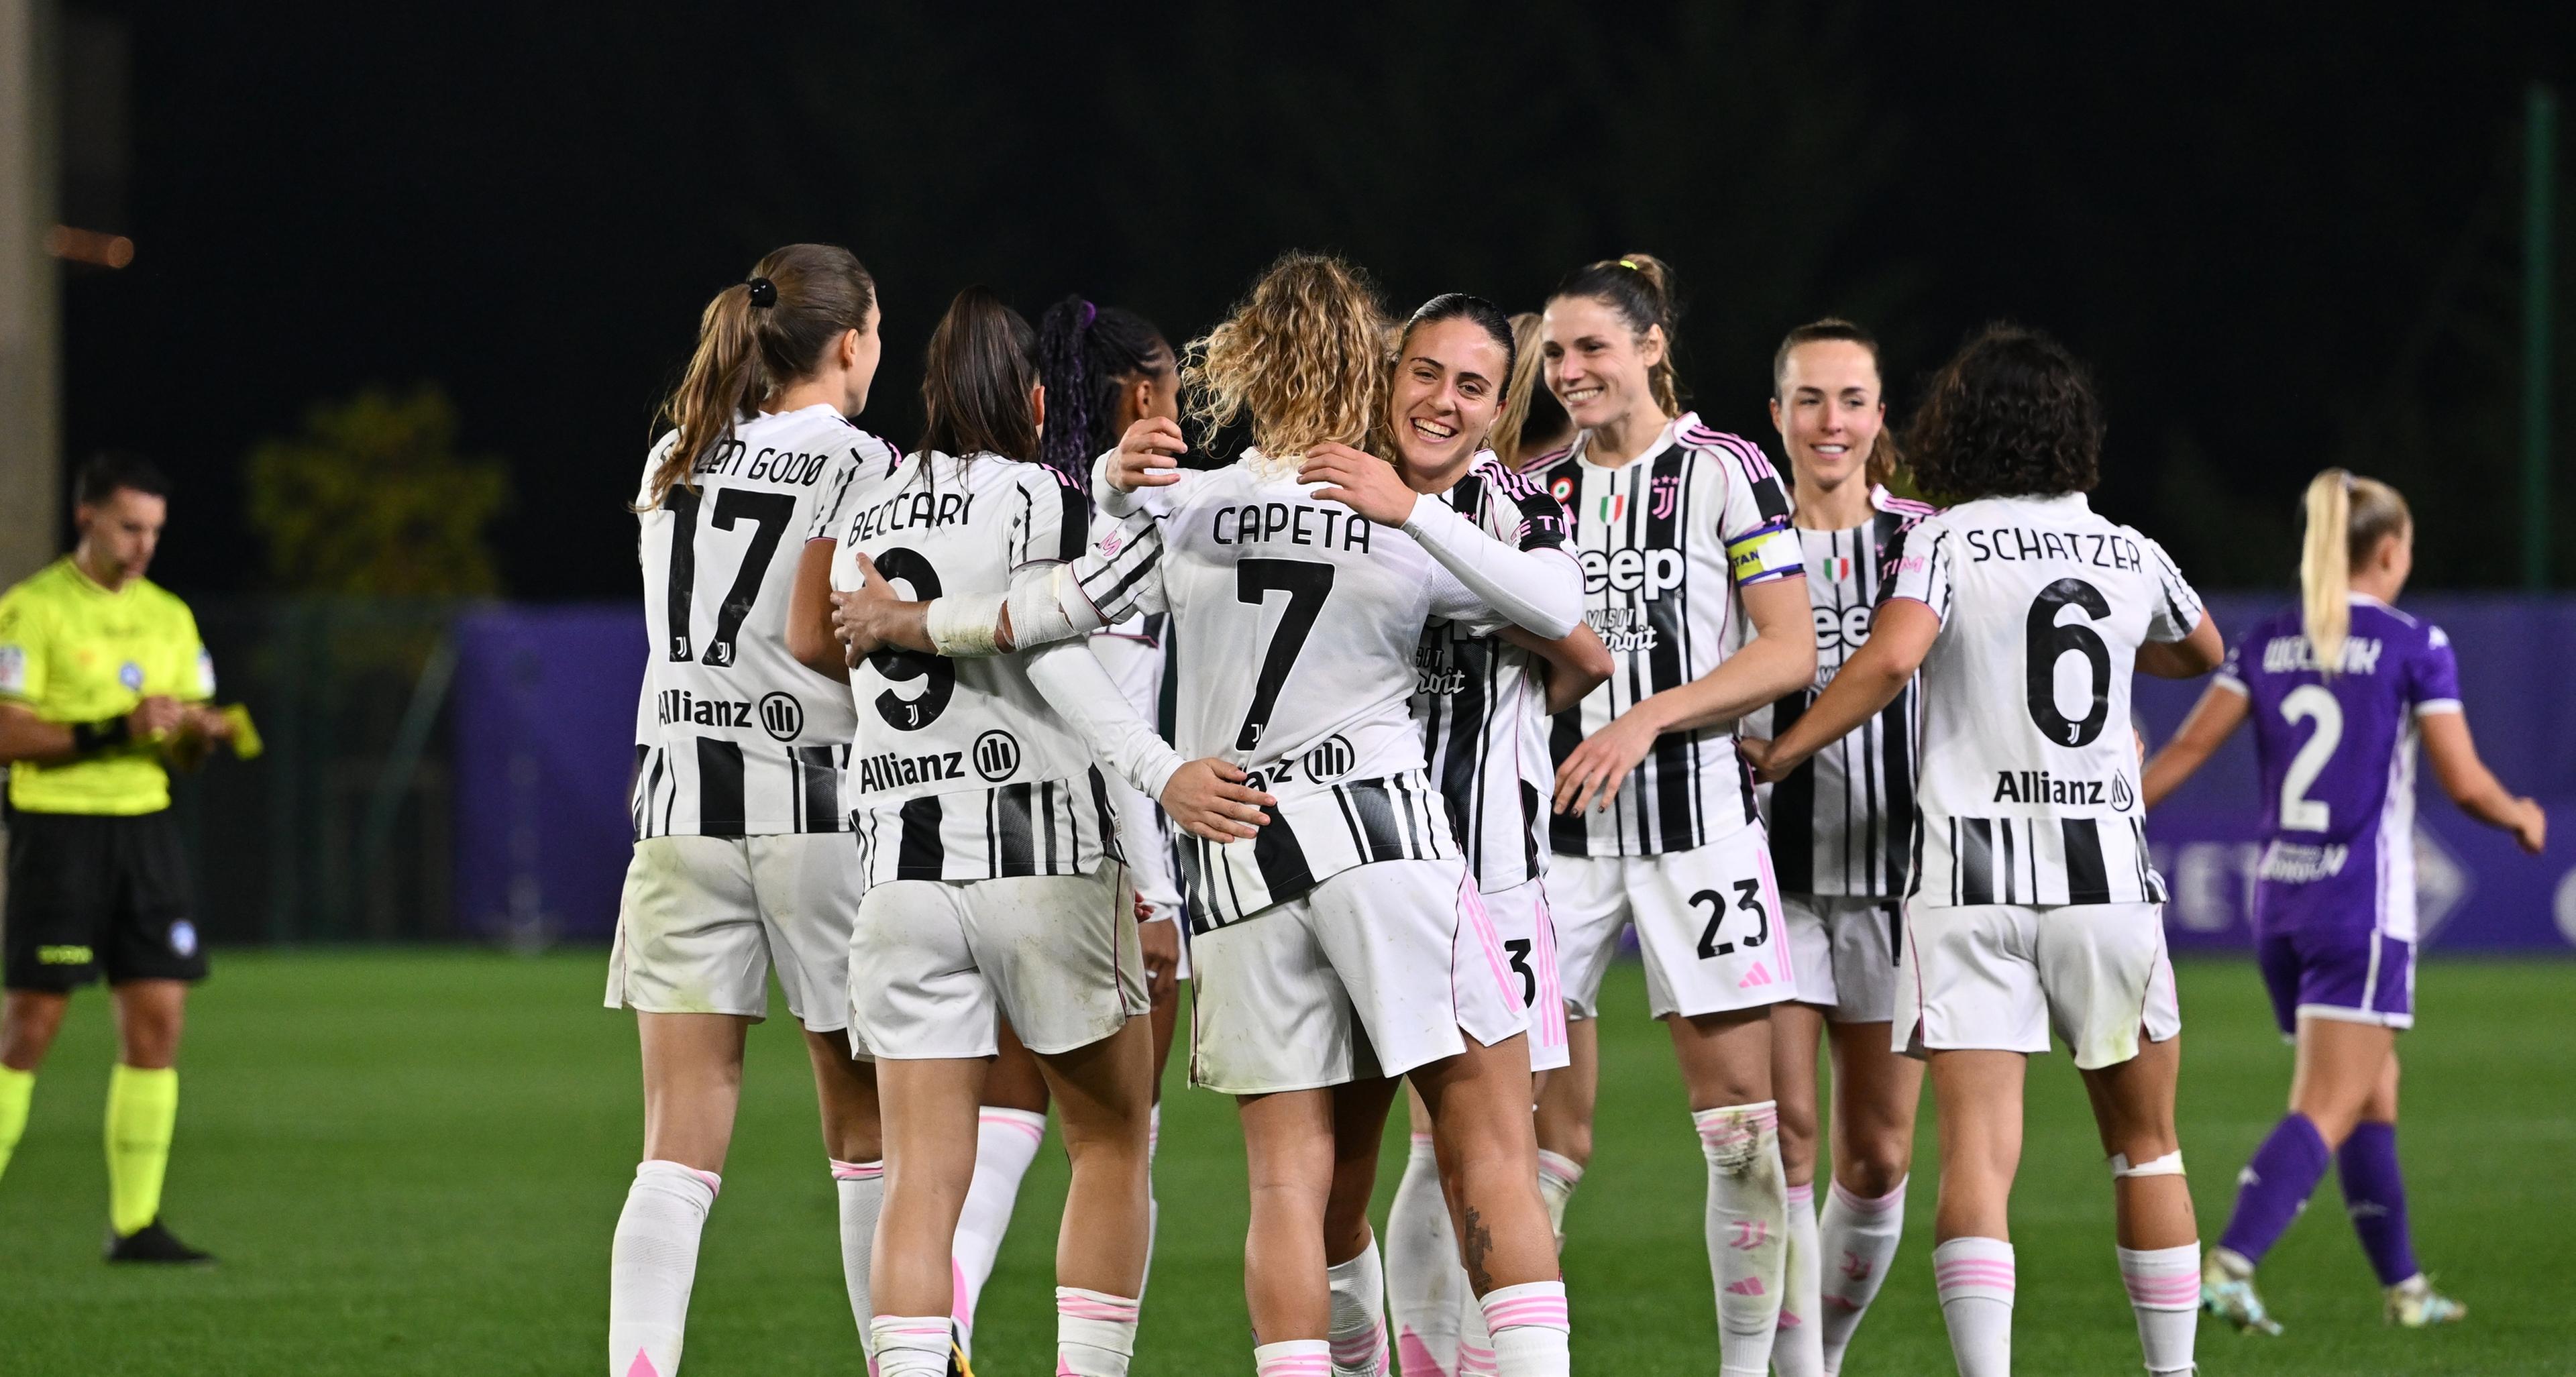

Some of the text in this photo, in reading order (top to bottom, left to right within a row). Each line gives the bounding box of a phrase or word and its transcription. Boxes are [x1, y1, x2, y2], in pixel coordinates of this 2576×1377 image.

[747, 447, 829, 487] GODØ
[847, 492, 975, 549] BECCARI
[1213, 503, 1371, 554] CAPETA
[1966, 527, 2143, 573] SCHATZER
[660, 484, 797, 667] 17
[1578, 547, 1684, 602] eep
[868, 547, 955, 731] 9
[1586, 607, 1635, 629] VISIT
[1599, 624, 1658, 652] troit
[1812, 606, 1872, 650] ee
[1236, 558, 1336, 751] 7
[2026, 577, 2112, 748] 6
[1417, 669, 1466, 694] roit
[658, 689, 753, 727] Allianz
[859, 750, 965, 794] Allianz
[2279, 683, 2344, 832] 2
[1992, 771, 2106, 806] Allianz
[1688, 878, 1769, 960] 23
